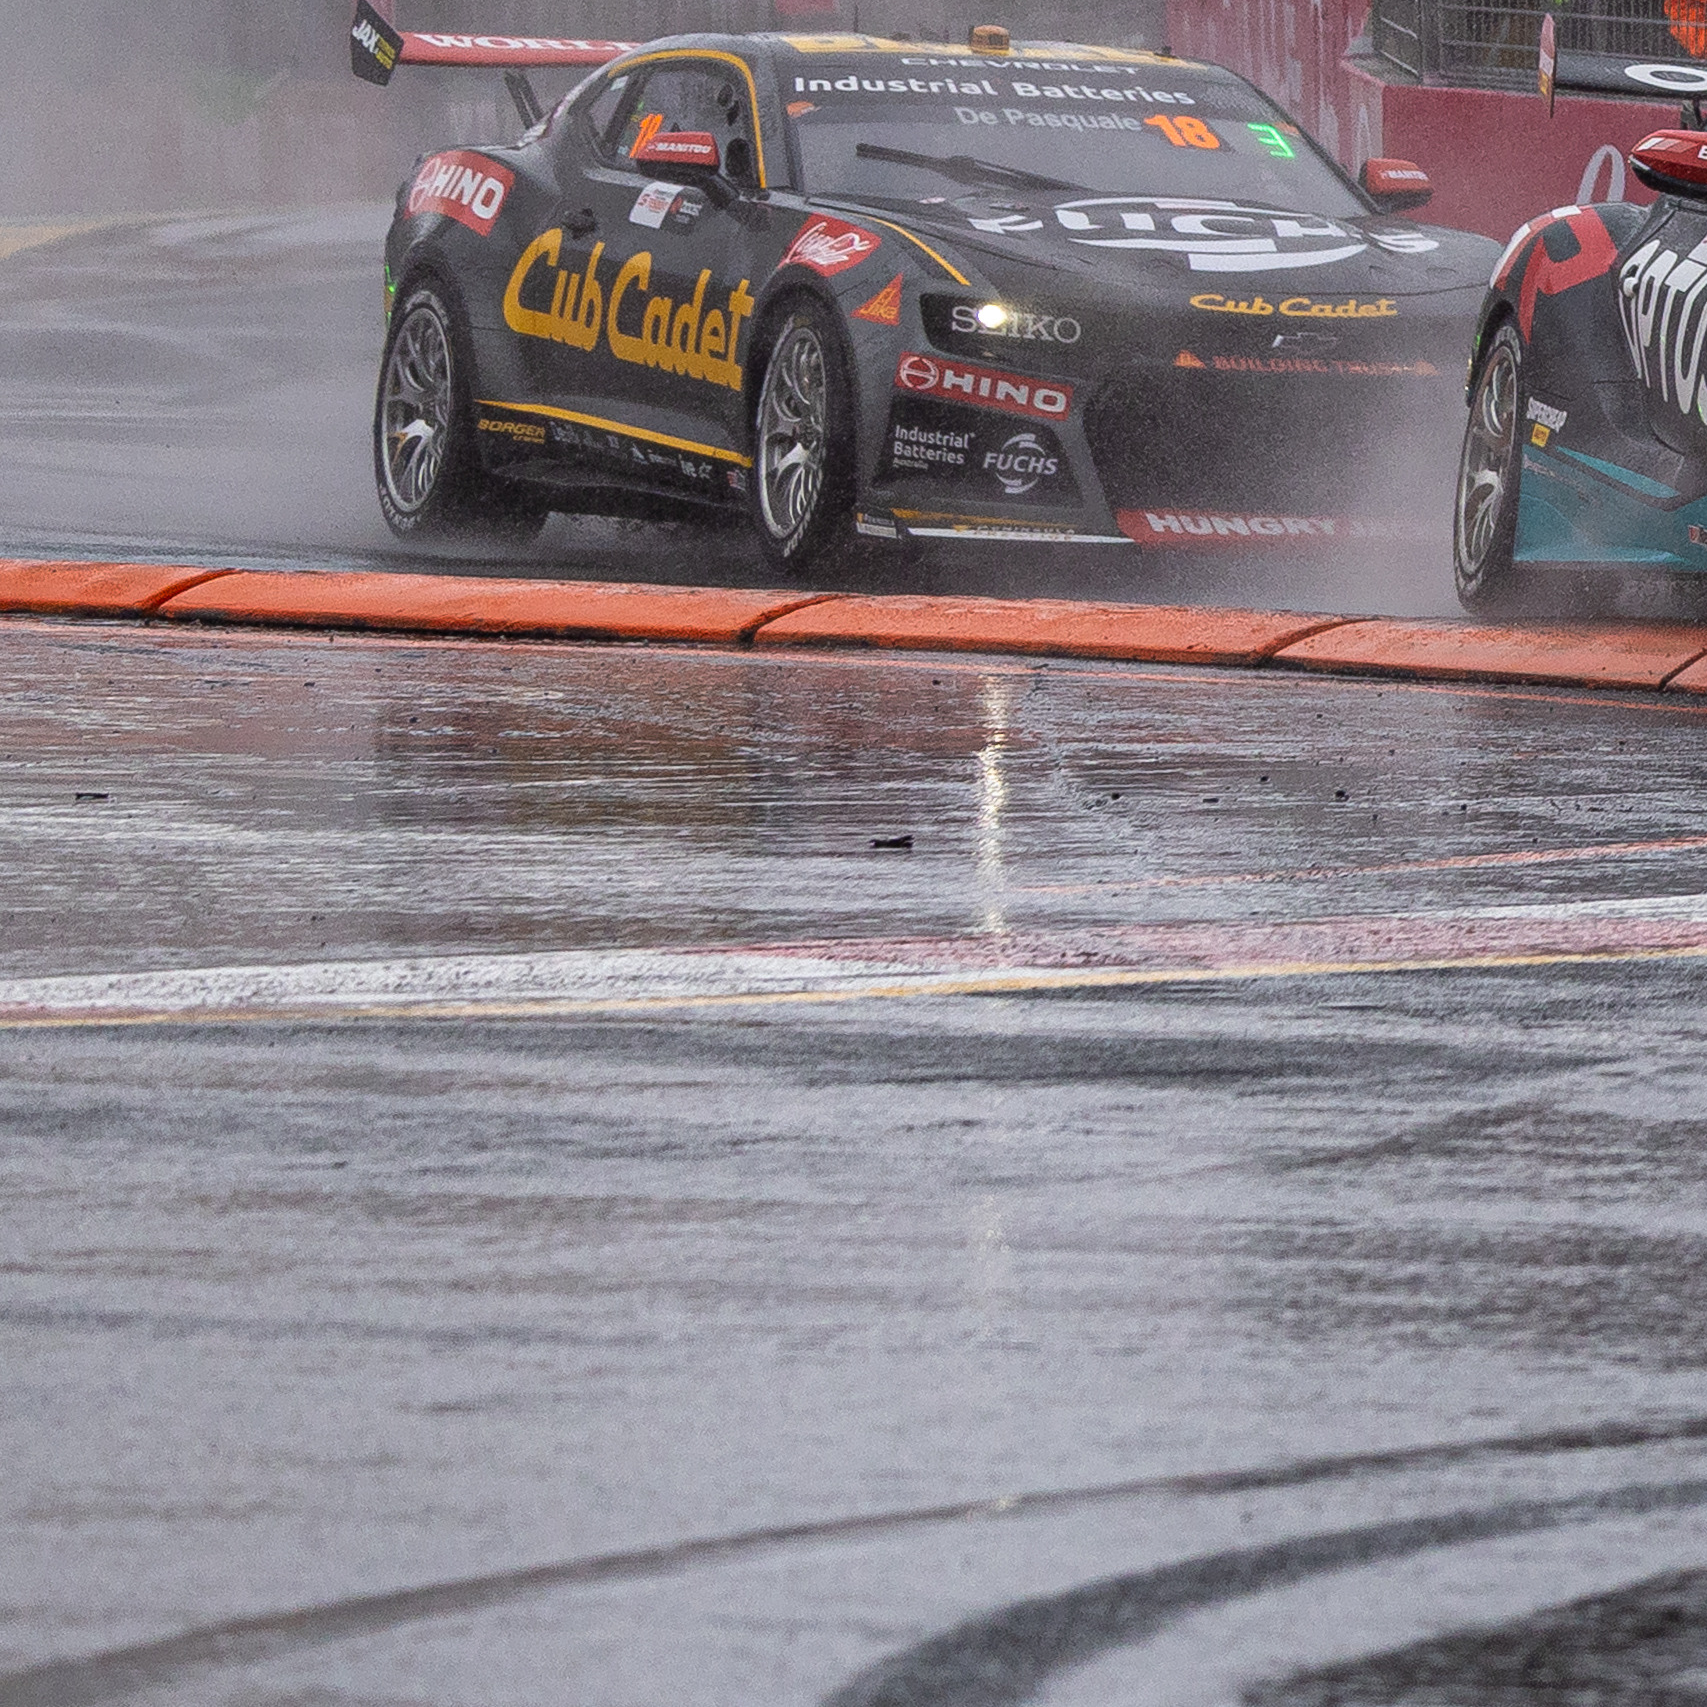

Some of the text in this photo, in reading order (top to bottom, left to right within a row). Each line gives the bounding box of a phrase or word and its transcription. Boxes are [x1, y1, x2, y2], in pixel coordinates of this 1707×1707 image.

[352, 19, 380, 54] JAX
[901, 57, 1142, 74] CHEVROLET
[795, 76, 1195, 105] Industrial Batteries
[954, 106, 1142, 131] De Pasquale
[1144, 114, 1220, 150] 18
[659, 143, 711, 154] MANITOU
[432, 164, 505, 220] HINO
[503, 228, 754, 391] Cub Cadet
[1190, 294, 1398, 318] Cub Cadet
[943, 369, 1066, 412] HINO
[477, 419, 545, 438] BORGER
[895, 425, 970, 449] Industrial
[894, 442, 964, 464] Batteries
[982, 452, 1058, 475] FUCHS
[1146, 514, 1336, 535] HUNGRY
